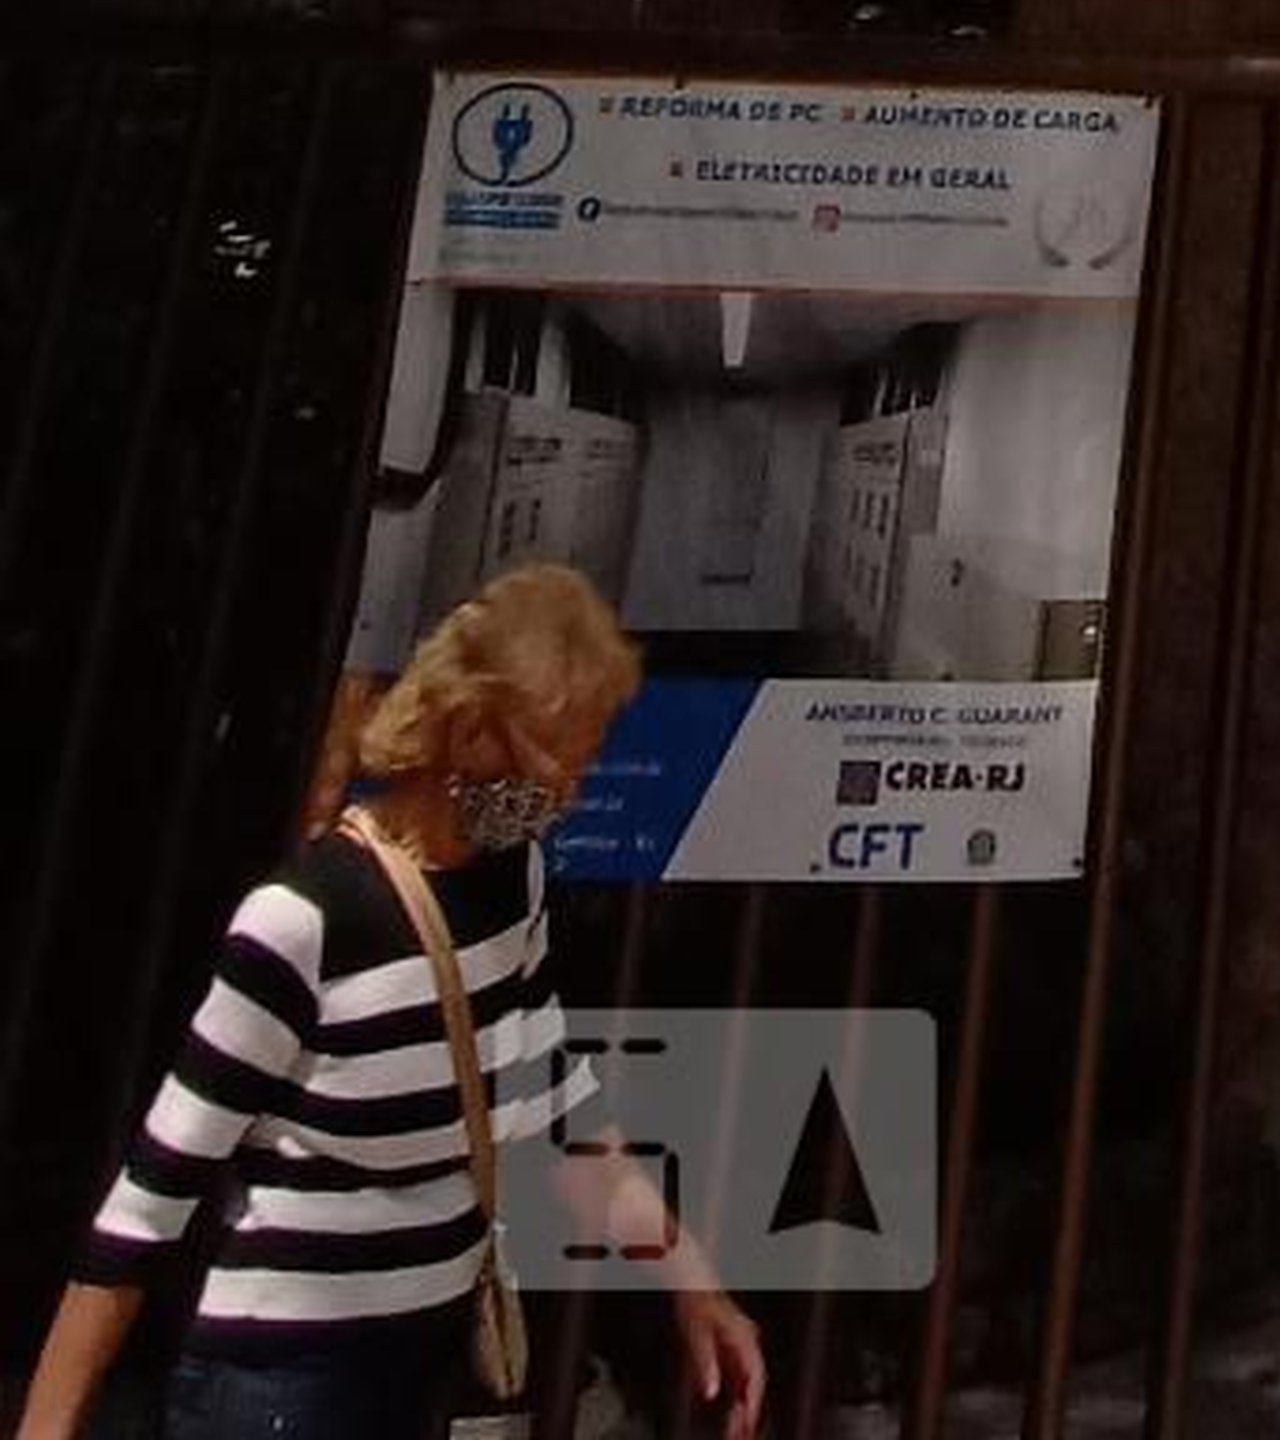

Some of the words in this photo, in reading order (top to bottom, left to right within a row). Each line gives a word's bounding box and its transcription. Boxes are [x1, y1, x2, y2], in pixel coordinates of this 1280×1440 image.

[619, 96, 741, 122] REFORMA
[750, 100, 783, 122] DE
[790, 104, 822, 123] PC
[864, 105, 986, 129] AUMENTO
[992, 107, 1027, 129] DE
[1034, 108, 1119, 133] CARGA
[696, 160, 878, 186] ELETRICIDADE
[886, 166, 922, 187] EM
[929, 166, 1011, 190] GERAL
[827, 823, 925, 870] CFT
